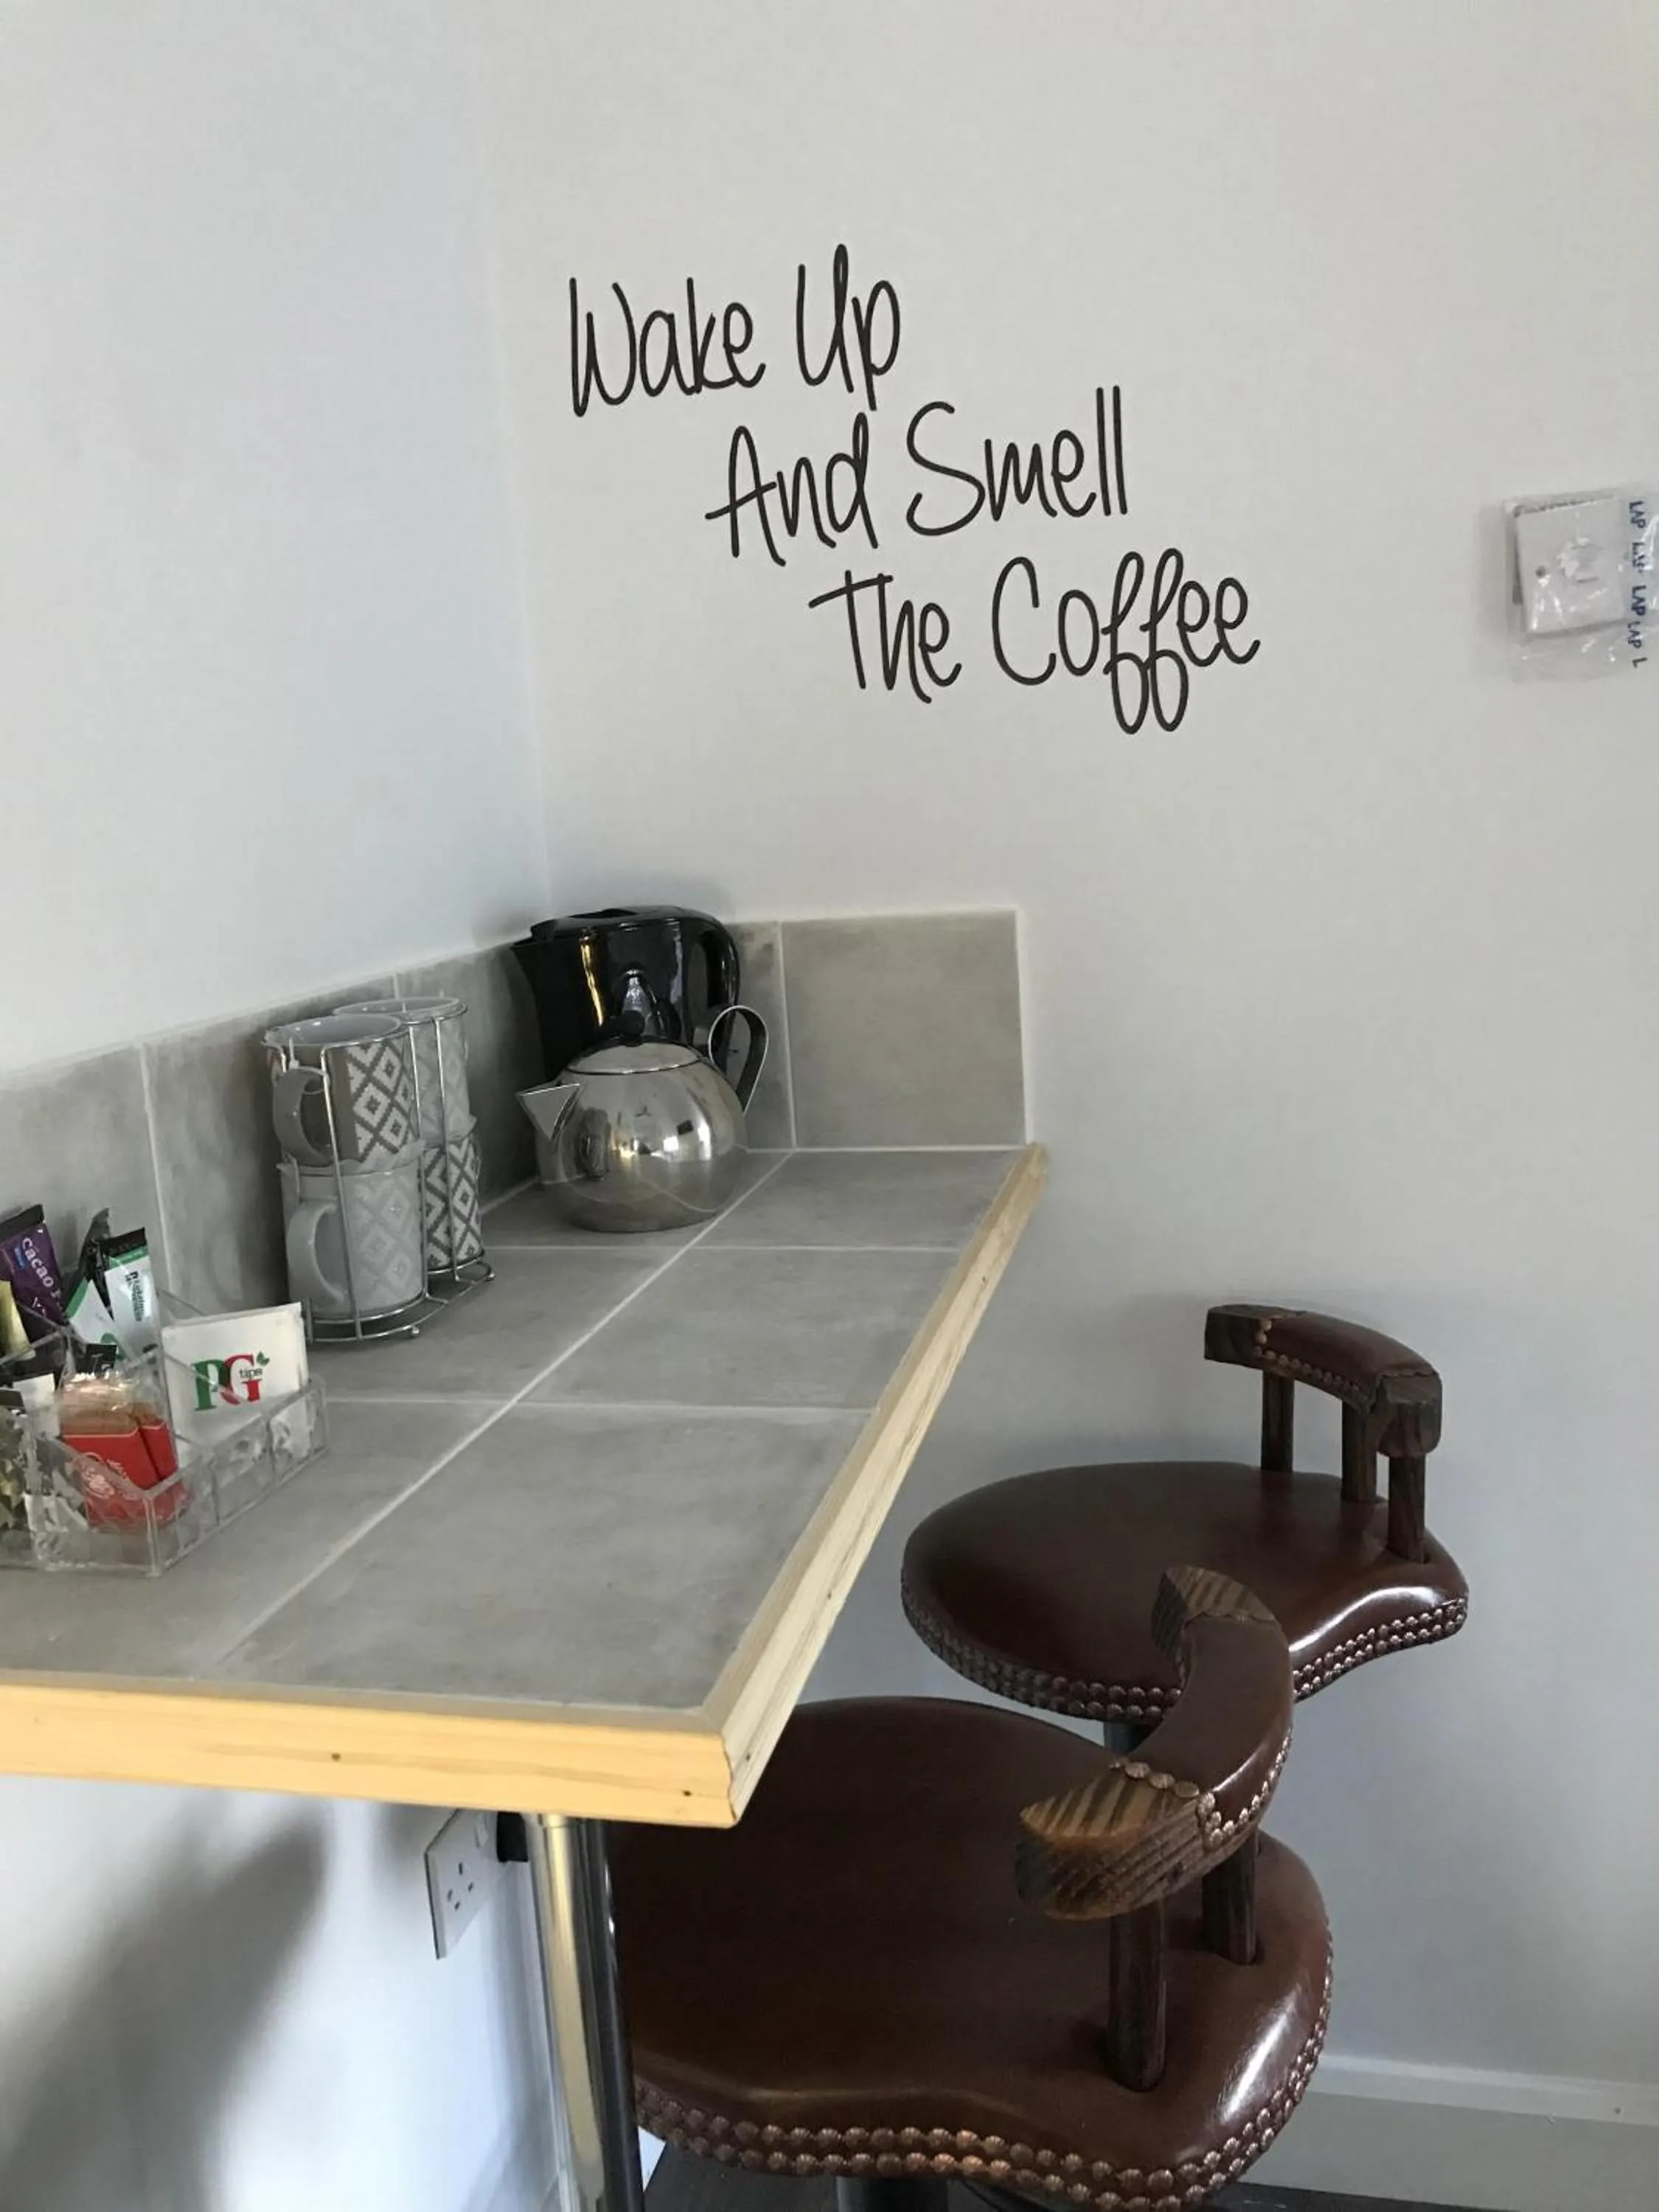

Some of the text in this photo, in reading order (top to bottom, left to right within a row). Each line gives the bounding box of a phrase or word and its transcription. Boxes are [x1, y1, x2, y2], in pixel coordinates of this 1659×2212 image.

[570, 244, 900, 417] Wake Up
[705, 386, 1127, 566] And Smell
[1629, 501, 1646, 529] LAP
[1631, 585, 1646, 617] LAP
[809, 549, 1260, 734] The Coffee
[1627, 621, 1644, 649] LAP
[22, 1237, 54, 1287] Cacao
[189, 1354, 260, 1411] PG
